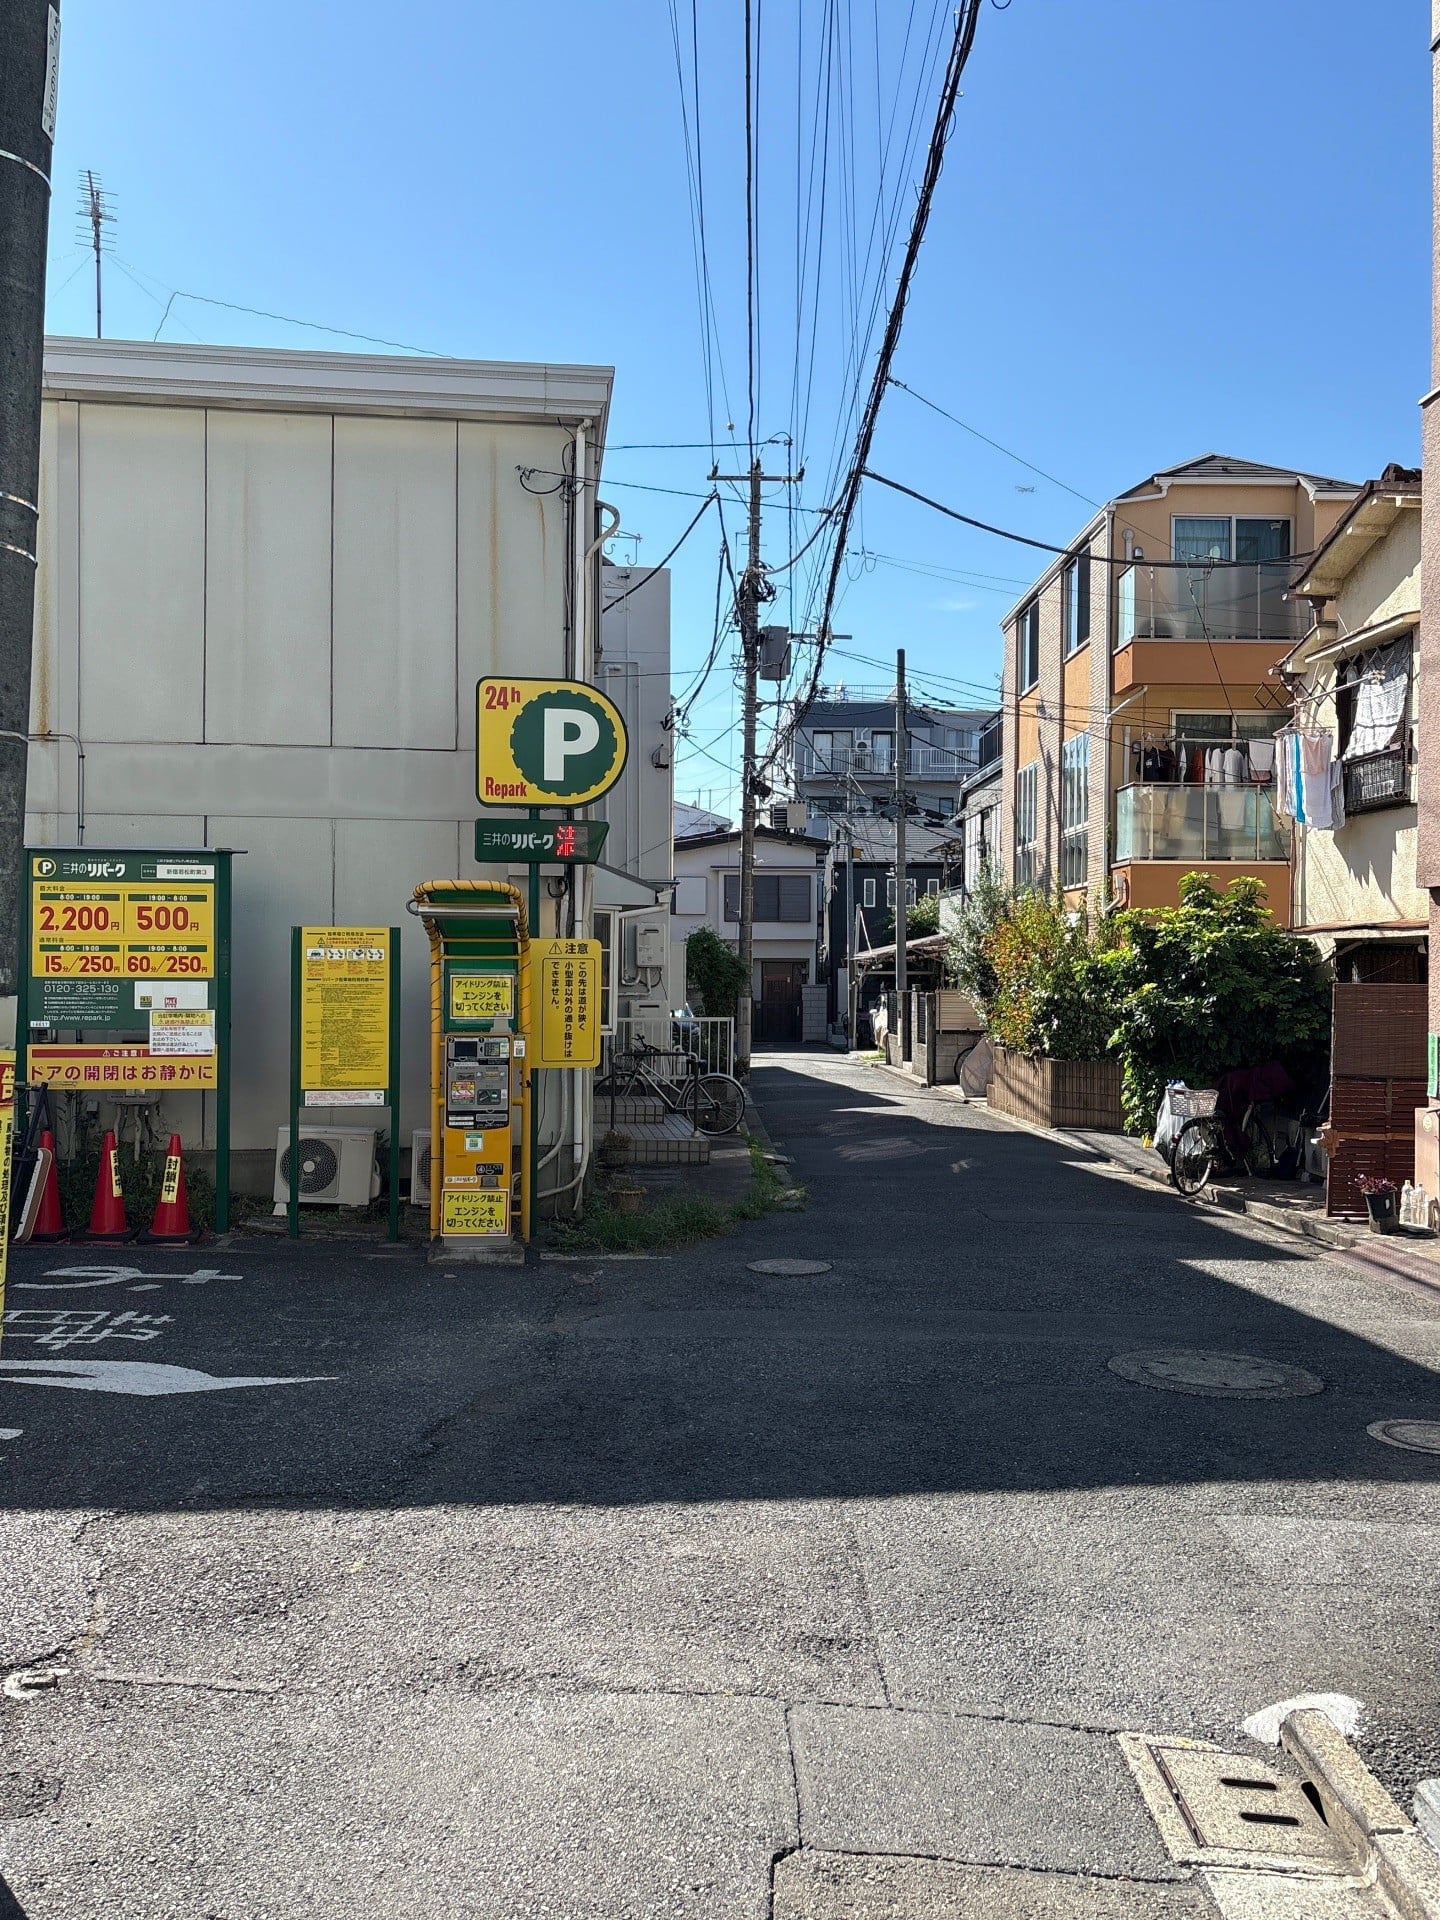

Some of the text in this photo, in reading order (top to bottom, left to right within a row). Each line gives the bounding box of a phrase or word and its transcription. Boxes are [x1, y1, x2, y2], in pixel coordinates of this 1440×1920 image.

[485, 686, 521, 710] 24h
[543, 708, 600, 781] P
[485, 777, 527, 799] Repark
[483, 832, 554, 849] 三井のリパーク
[62, 862, 126, 877] 三井のリパーク
[565, 943, 588, 955] 注意
[44, 985, 119, 993] 0120-325-130
[455, 980, 509, 988] アイドリング禁止
[551, 961, 560, 1010] できません。
[462, 991, 502, 1001] エンジンを
[578, 961, 588, 1031] この先は道が狭く
[455, 1002, 510, 1012] 切ってください
[564, 961, 574, 1058] 小型車以外の通り抜けは
[31, 1065, 213, 1081] ドアの開閉はお静かに
[164, 1158, 178, 1196] 封鎖中
[447, 1194, 504, 1203] アイドリング禁止
[454, 1206, 496, 1216] エンジンを
[446, 1217, 504, 1228] 切ってください
